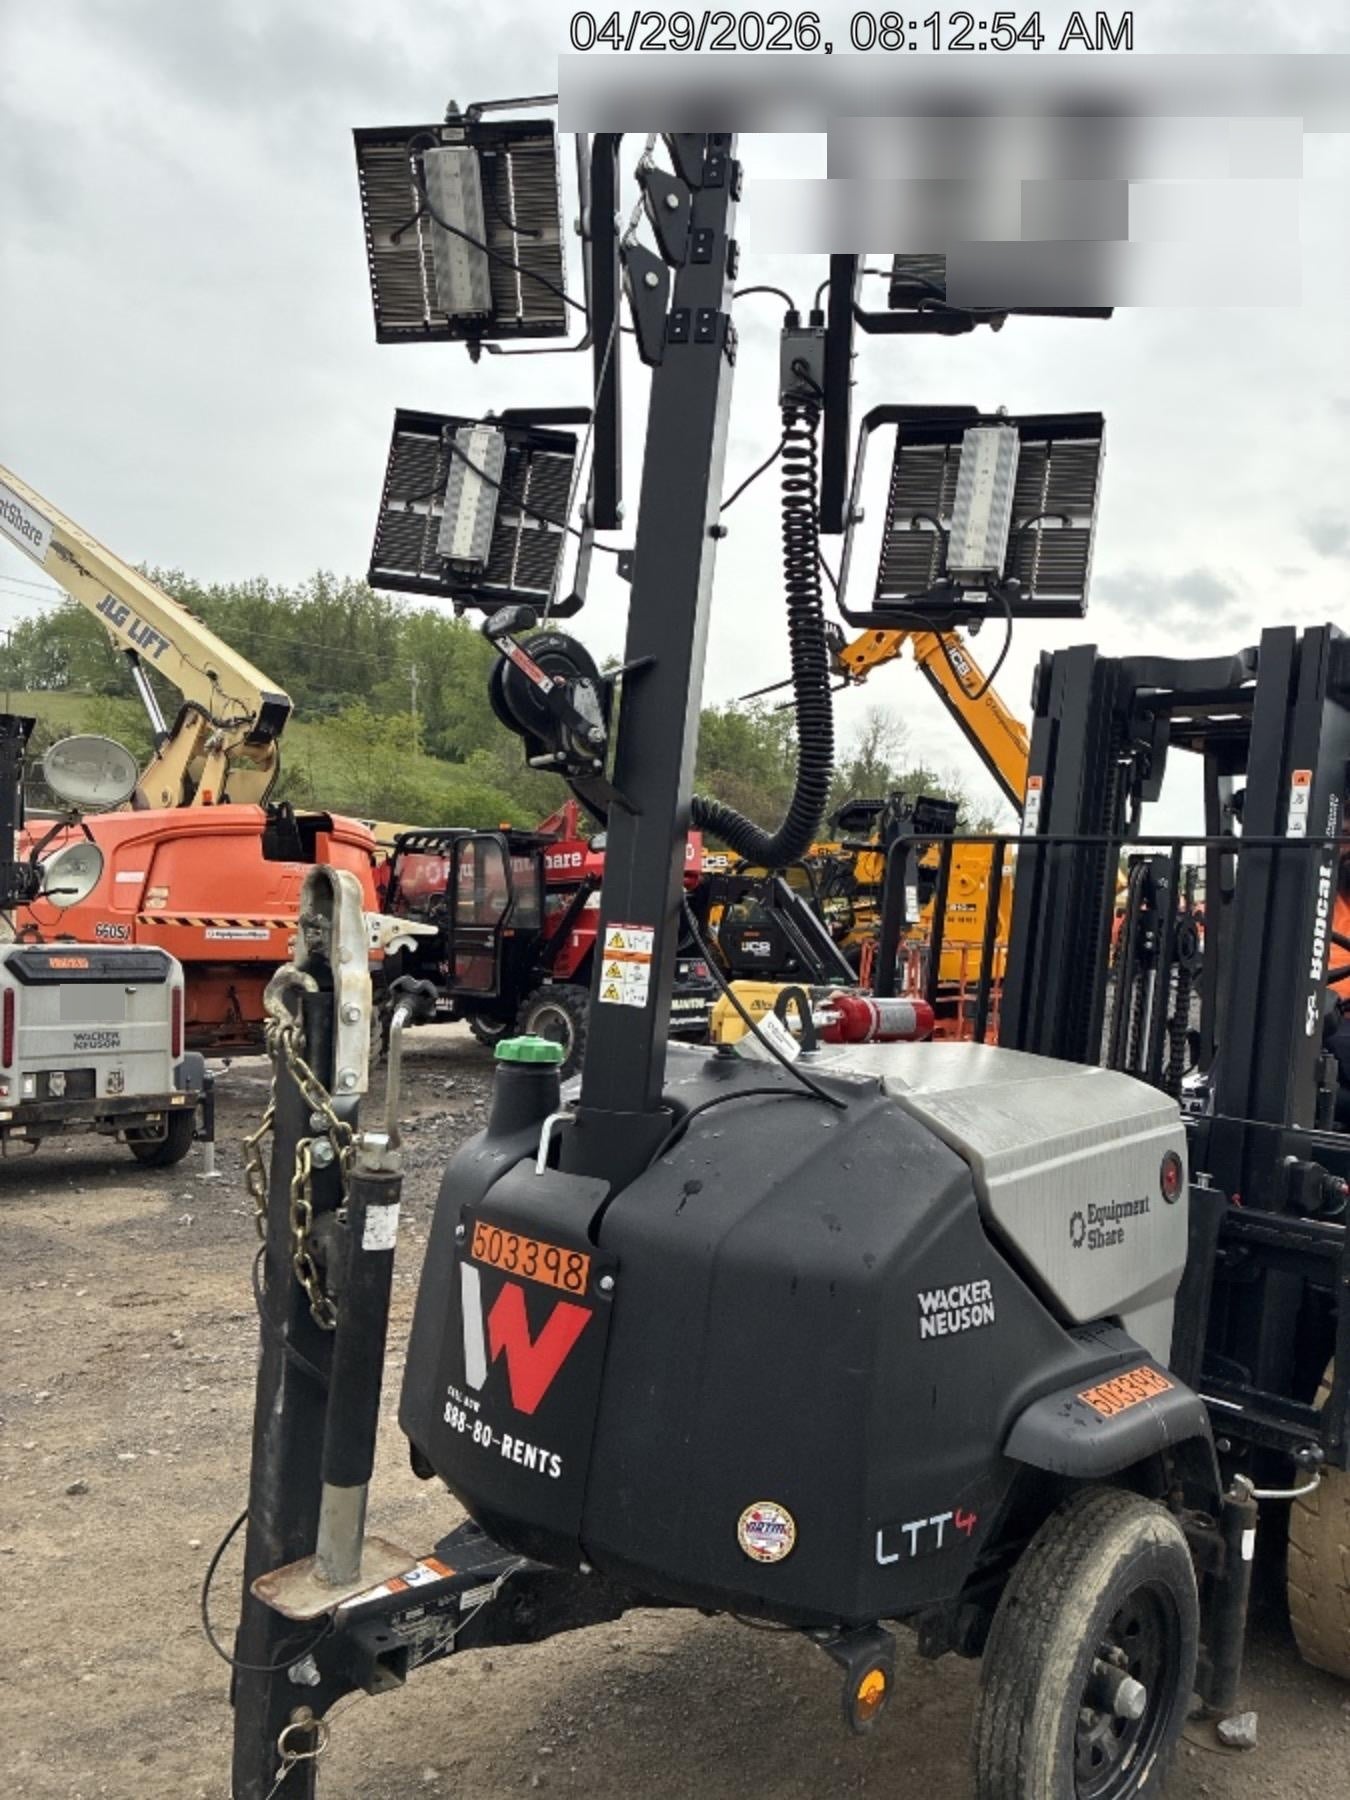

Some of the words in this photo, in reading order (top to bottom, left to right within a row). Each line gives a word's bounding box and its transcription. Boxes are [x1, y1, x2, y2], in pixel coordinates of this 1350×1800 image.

[96, 593, 131, 628] JLG
[128, 618, 171, 660] LIFT
[1087, 1195, 1151, 1227] Equipment
[474, 1223, 583, 1292] 503398
[1087, 1227, 1125, 1250] Share
[917, 1279, 993, 1315] WACKER
[919, 1301, 996, 1339] NEUSON
[443, 1401, 562, 1478] 888-80-RENTS
